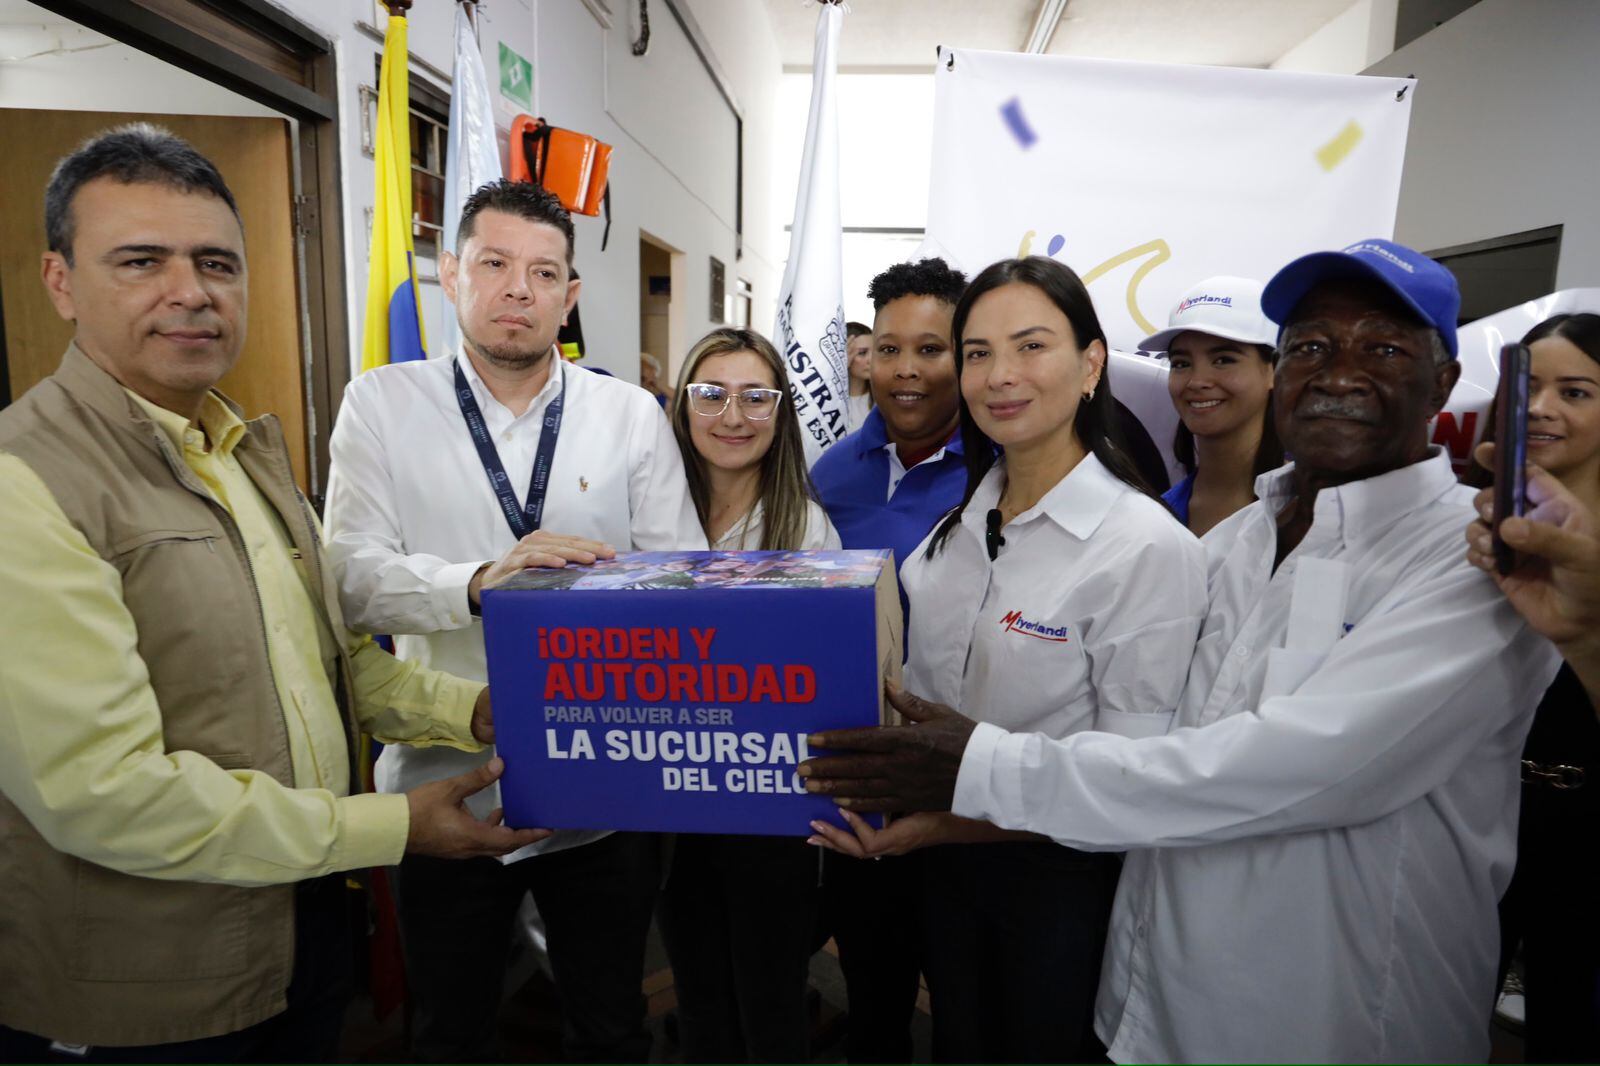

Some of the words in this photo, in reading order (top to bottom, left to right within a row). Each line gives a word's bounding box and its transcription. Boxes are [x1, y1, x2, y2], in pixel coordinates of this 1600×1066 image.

[999, 610, 1067, 638] Miyerlandi
[689, 627, 716, 660] Y
[543, 662, 817, 703] AUTORIDAD
[544, 706, 596, 723] PARA
[599, 706, 674, 724] VOLVER
[677, 708, 692, 724] A
[695, 708, 734, 725] SER
[545, 728, 596, 760] LA
[604, 729, 818, 765] SUCURSAL
[662, 767, 718, 791] DEL
